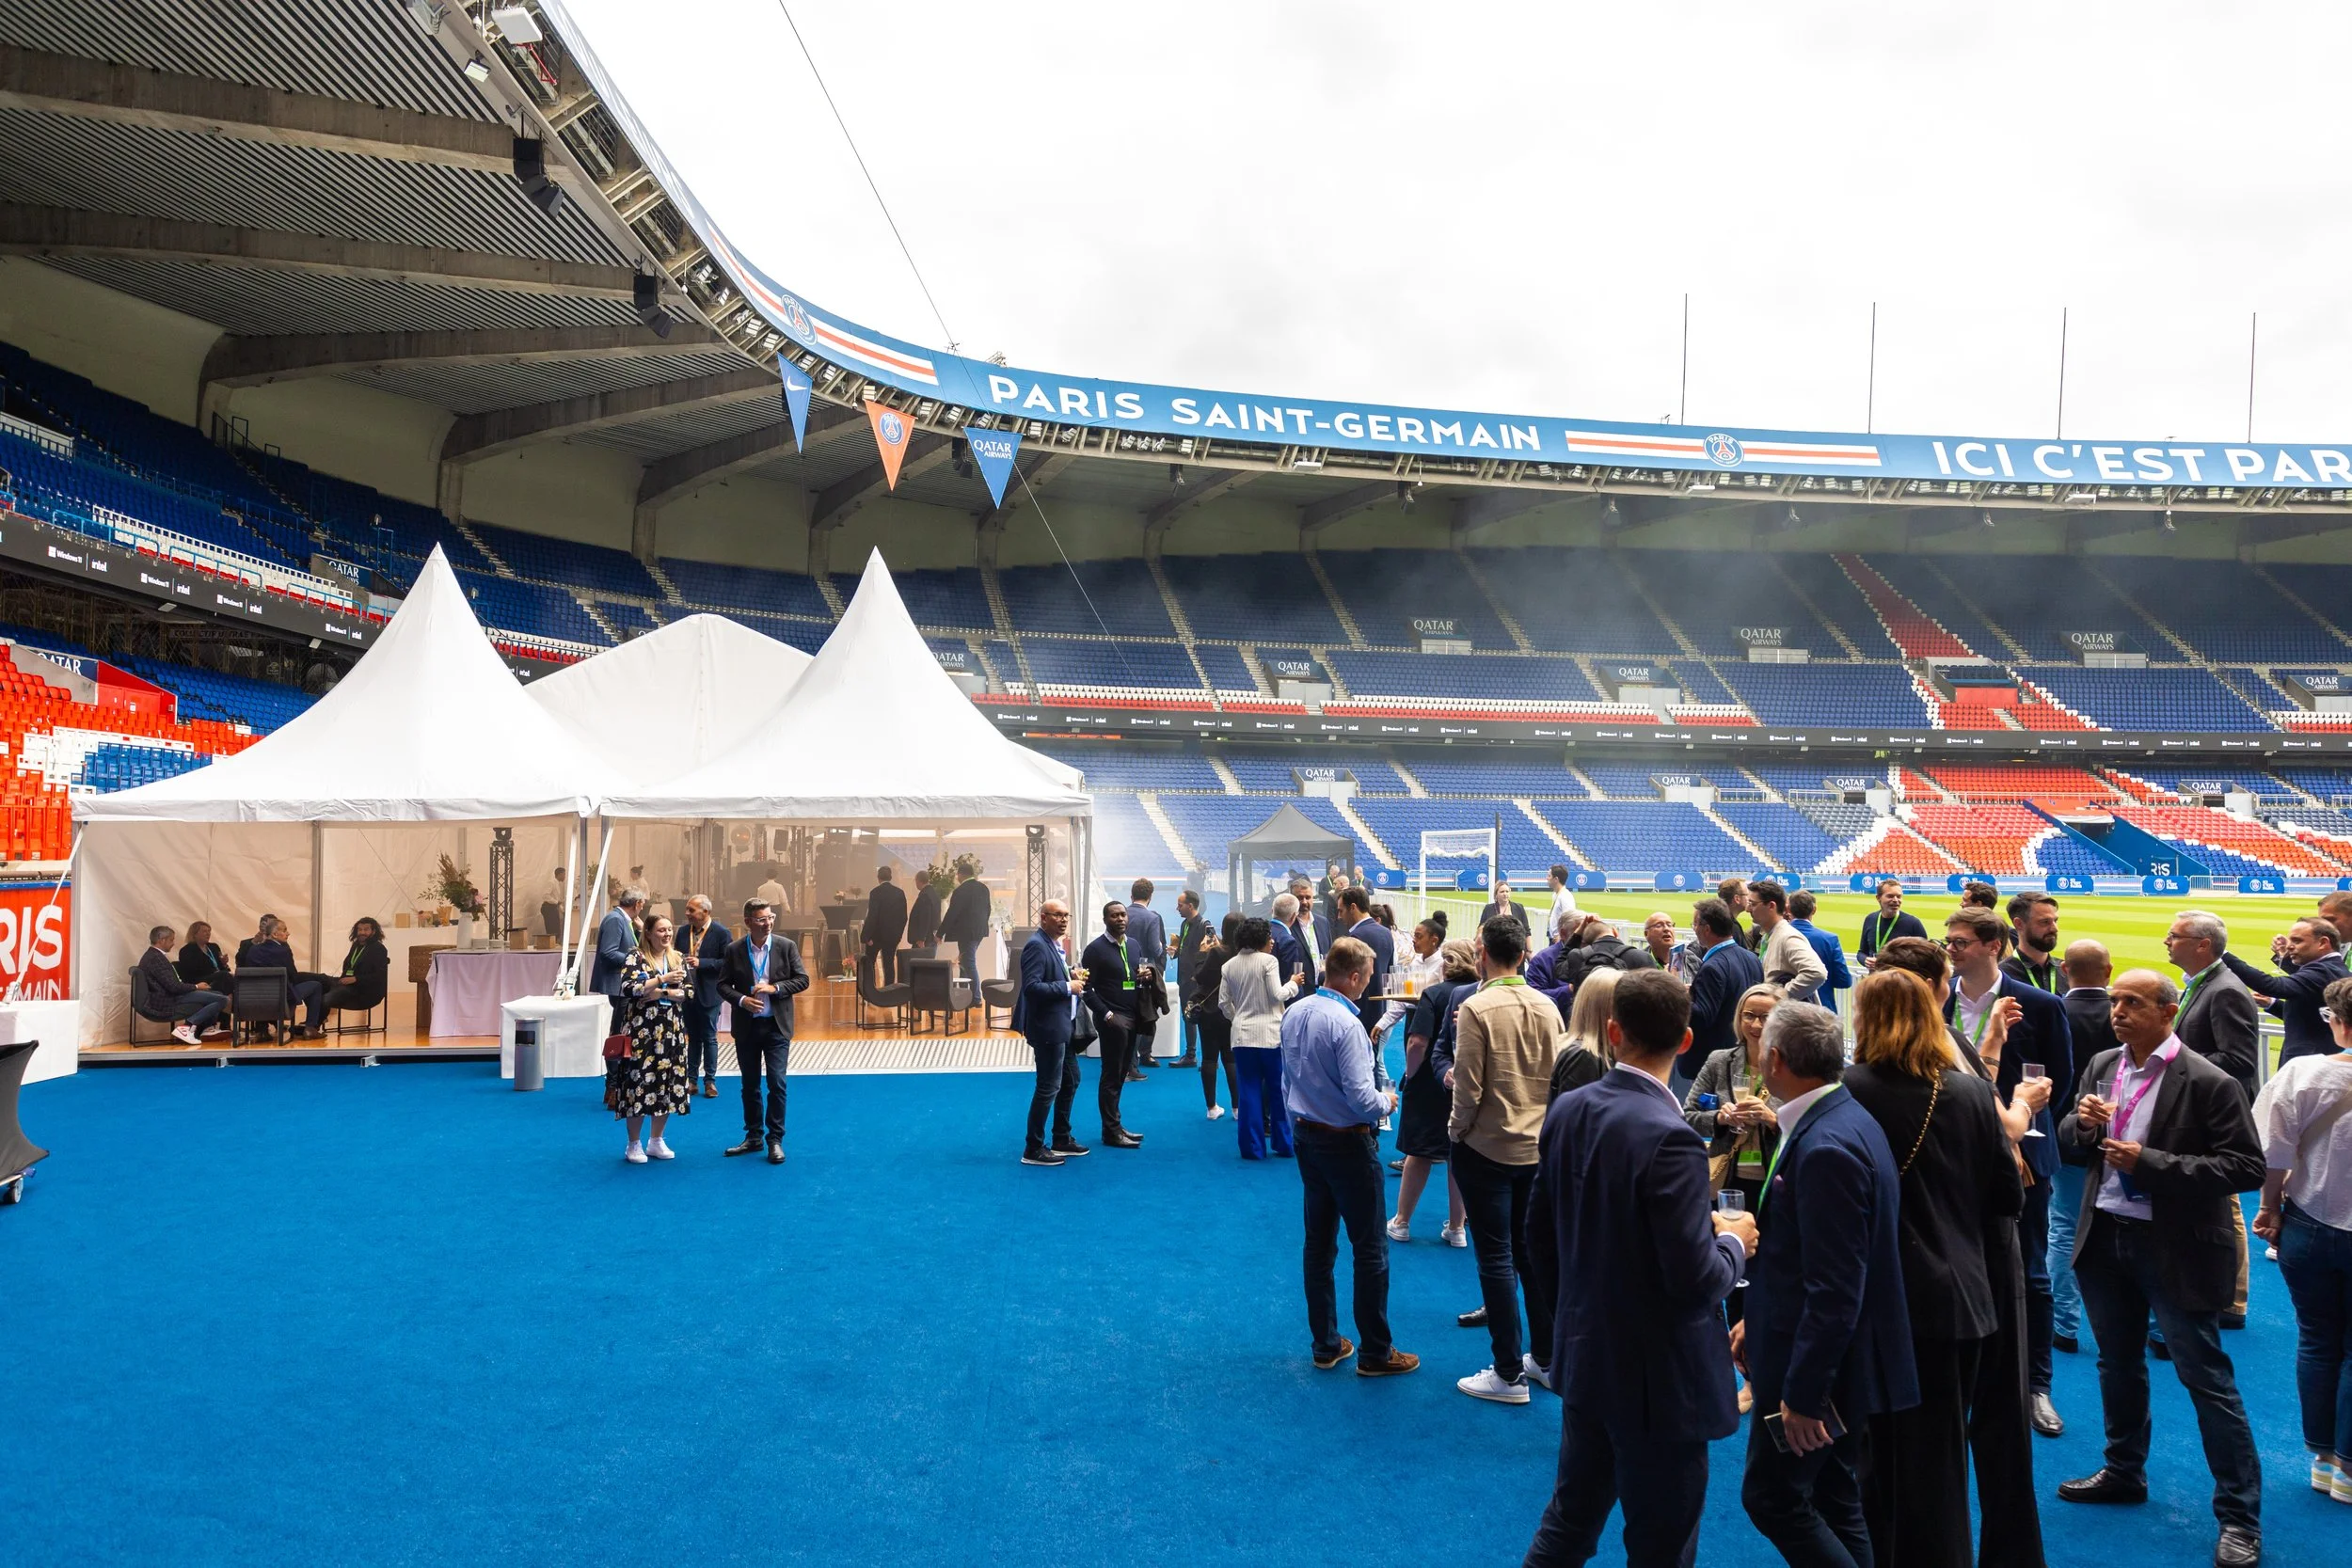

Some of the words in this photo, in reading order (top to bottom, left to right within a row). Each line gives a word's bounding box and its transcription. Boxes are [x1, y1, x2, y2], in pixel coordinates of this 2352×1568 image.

[988, 374, 1144, 420] PARIS
[1170, 398, 1541, 451] SAINT-GERMAIN
[974, 440, 1011, 452] QATAR
[984, 451, 1012, 460] AIRWAYS
[1931, 441, 2015, 478] ICI
[2033, 444, 2205, 482] C'EST
[56, 549, 77, 562] Windows
[91, 559, 107, 572] intel
[177, 583, 190, 594] intel
[1413, 619, 1453, 631] QATAR
[1740, 627, 1782, 641] QATAR
[2072, 632, 2114, 645] QATAR
[1278, 661, 1310, 672] QATAR
[1618, 667, 1649, 677] QATAR
[2306, 676, 2338, 686] QATAR
[1305, 768, 1335, 779] QATAR
[1661, 776, 1691, 785] QATAR
[1836, 779, 1866, 788] QATAR
[2192, 782, 2221, 792] QATAR
